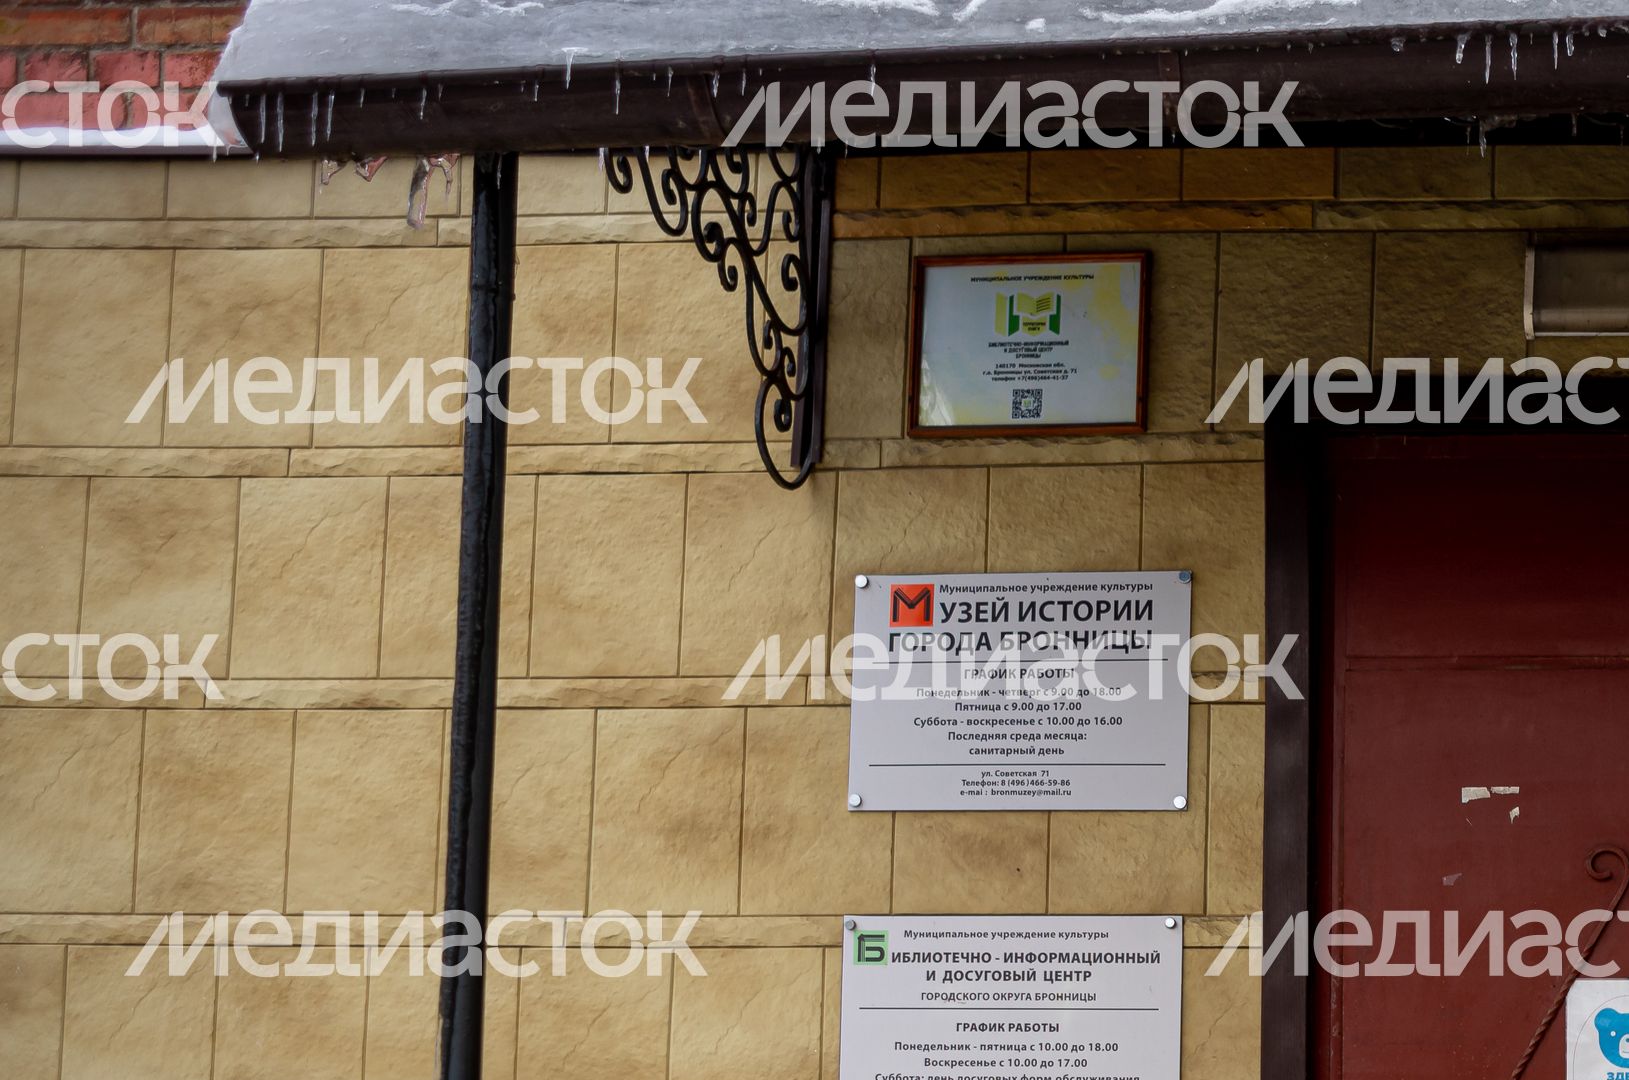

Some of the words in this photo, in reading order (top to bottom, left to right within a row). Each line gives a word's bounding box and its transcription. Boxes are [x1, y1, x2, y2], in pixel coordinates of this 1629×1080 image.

[940, 584, 1027, 594] Муниципальное
[1031, 584, 1097, 593] учреждение
[1101, 583, 1153, 592] культуры
[1018, 600, 1153, 622] ИСТОРИИ
[889, 631, 992, 655] ГОРОДА
[1000, 629, 1152, 653] БРОННИЦЫ
[964, 668, 1016, 681] ГРАФИК
[1020, 668, 1074, 679] РАБОТЫ
[917, 688, 989, 699] Понедельник
[999, 689, 1040, 699] четверг
[1052, 688, 1073, 696] 9.00
[1076, 689, 1089, 697] до
[1094, 687, 1121, 696] 18.00
[955, 703, 1001, 712] Пятница
[1012, 703, 1033, 711] 9.00
[1037, 704, 1050, 713] до
[1053, 703, 1081, 711] 17.00
[914, 717, 957, 727] Суббота
[967, 718, 1035, 727] воскресенье
[1046, 717, 1074, 726] 10.00
[1077, 719, 1090, 728] до
[1094, 717, 1122, 725] 16.00
[948, 732, 1007, 742] Последняя
[1010, 733, 1042, 742] среда
[1044, 733, 1086, 742] месяца:
[969, 746, 1035, 755] санитарный
[1039, 748, 1064, 757] день
[962, 780, 1000, 788] Телефон:
[991, 788, 1071, 798] bronmuzey@mail.ru
[904, 930, 988, 939] Муниципальное
[991, 931, 1055, 939] учреждение
[1059, 930, 1108, 939] культуры
[1004, 951, 1160, 965] ИНФОРМАЦИОННЫЙ
[927, 971, 935, 981] И
[942, 968, 1036, 984] ДОСУГОВЫЙ
[1043, 970, 1092, 984] ЦЕНТР
[922, 992, 990, 1003] ГОРОДСКОГО
[993, 992, 1032, 1001] ОКРУГА
[1035, 992, 1096, 1002] БРОННИЦЫ
[956, 1022, 1005, 1033] ГРАФИК
[1008, 1023, 1059, 1033] РАБОТЫ
[895, 1042, 971, 1052] Понедельник
[980, 1044, 1027, 1052] пятница
[1039, 1043, 1068, 1051] 10.00
[1071, 1044, 1085, 1053] до
[1088, 1043, 1118, 1052] 18.00
[925, 1058, 996, 1069] Воскресенье
[1008, 1058, 1037, 1067] 10.00
[1040, 1061, 1054, 1069] до
[1058, 1059, 1087, 1067] 17.00
